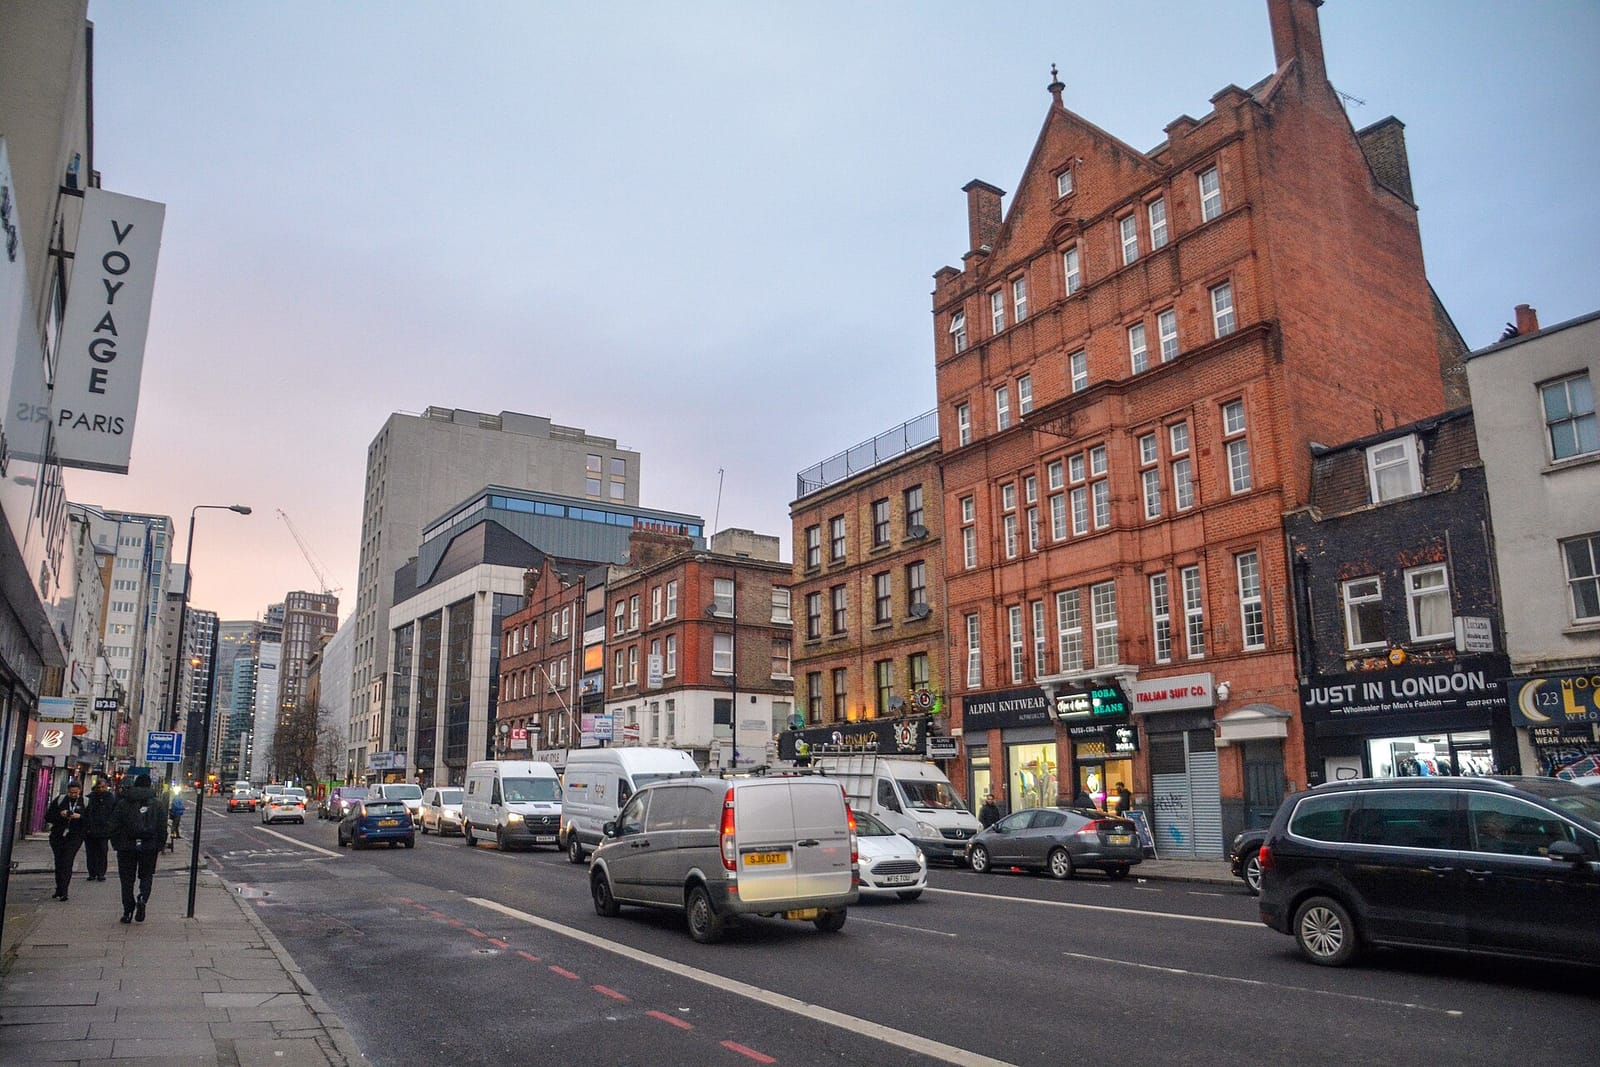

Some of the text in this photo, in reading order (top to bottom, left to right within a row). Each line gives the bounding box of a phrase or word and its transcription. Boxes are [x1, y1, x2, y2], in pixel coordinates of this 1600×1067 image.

[88, 219, 135, 394] VOYAGE
[58, 409, 125, 435] PARIS
[1091, 688, 1116, 698] BOBA
[1136, 685, 1206, 703] ITALIAN SUIT CO.
[1305, 684, 1356, 705] JUST
[1363, 681, 1384, 700] IN
[1390, 671, 1485, 698] LONDON
[95, 700, 117, 709] B2B
[1381, 703, 1392, 711] for
[1392, 700, 1414, 709] Men's
[1414, 699, 1442, 708] Fashion
[1535, 691, 1559, 706] 123
[968, 697, 1046, 715] ALPINI KNITWEAR
[1093, 702, 1124, 714] BEANS
[1534, 728, 1560, 736] MEN'S
[1536, 736, 1560, 744] WEAR
